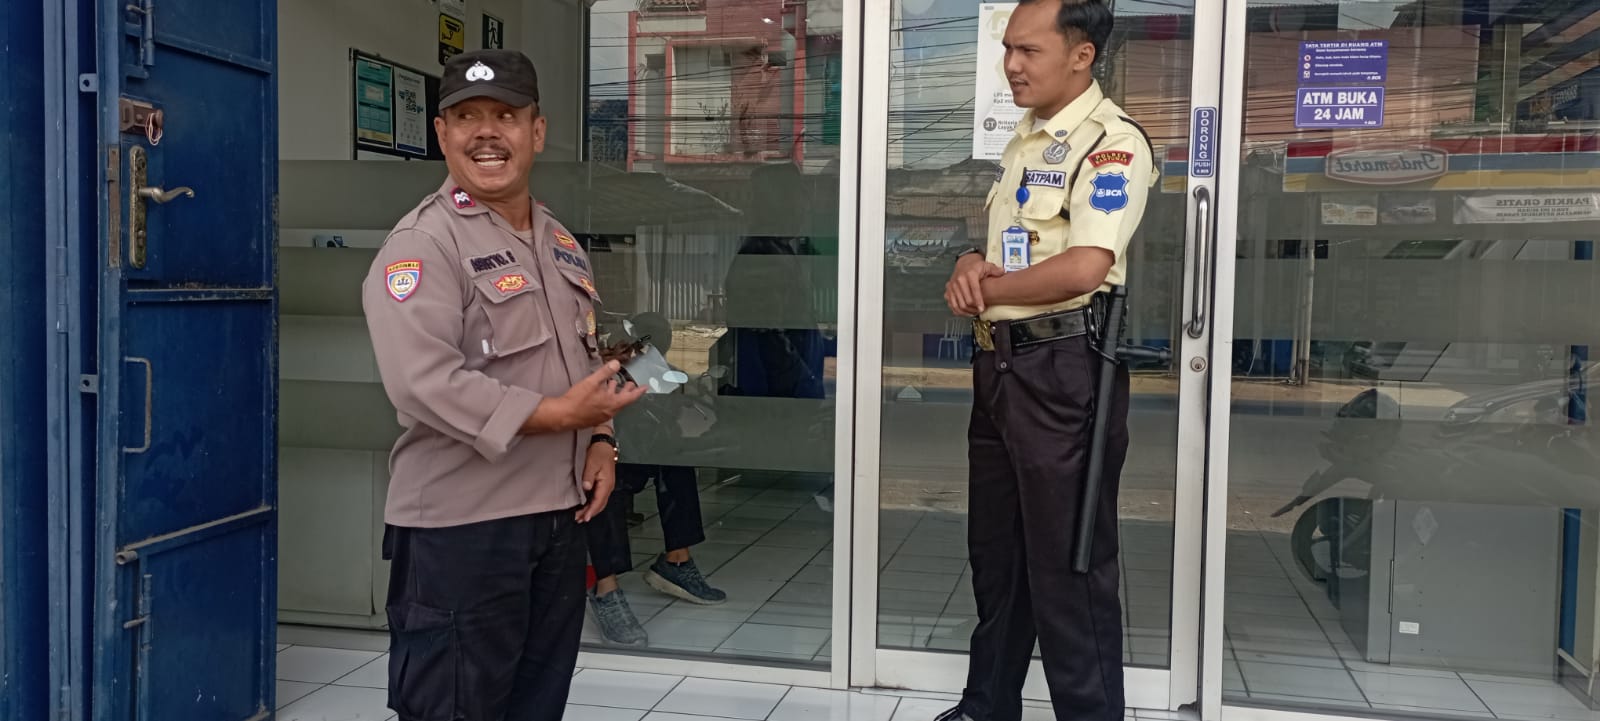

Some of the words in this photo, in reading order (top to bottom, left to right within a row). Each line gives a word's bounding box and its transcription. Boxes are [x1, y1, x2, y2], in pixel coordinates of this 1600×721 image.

[1302, 91, 1333, 105] ATM
[1337, 91, 1378, 104] BUKA
[1313, 108, 1331, 120] 24
[1334, 108, 1364, 120] JAM
[1198, 110, 1210, 159] DORONG
[1095, 152, 1126, 161] POLRES
[1025, 172, 1062, 186] SATPAM
[1105, 189, 1122, 197] BCA
